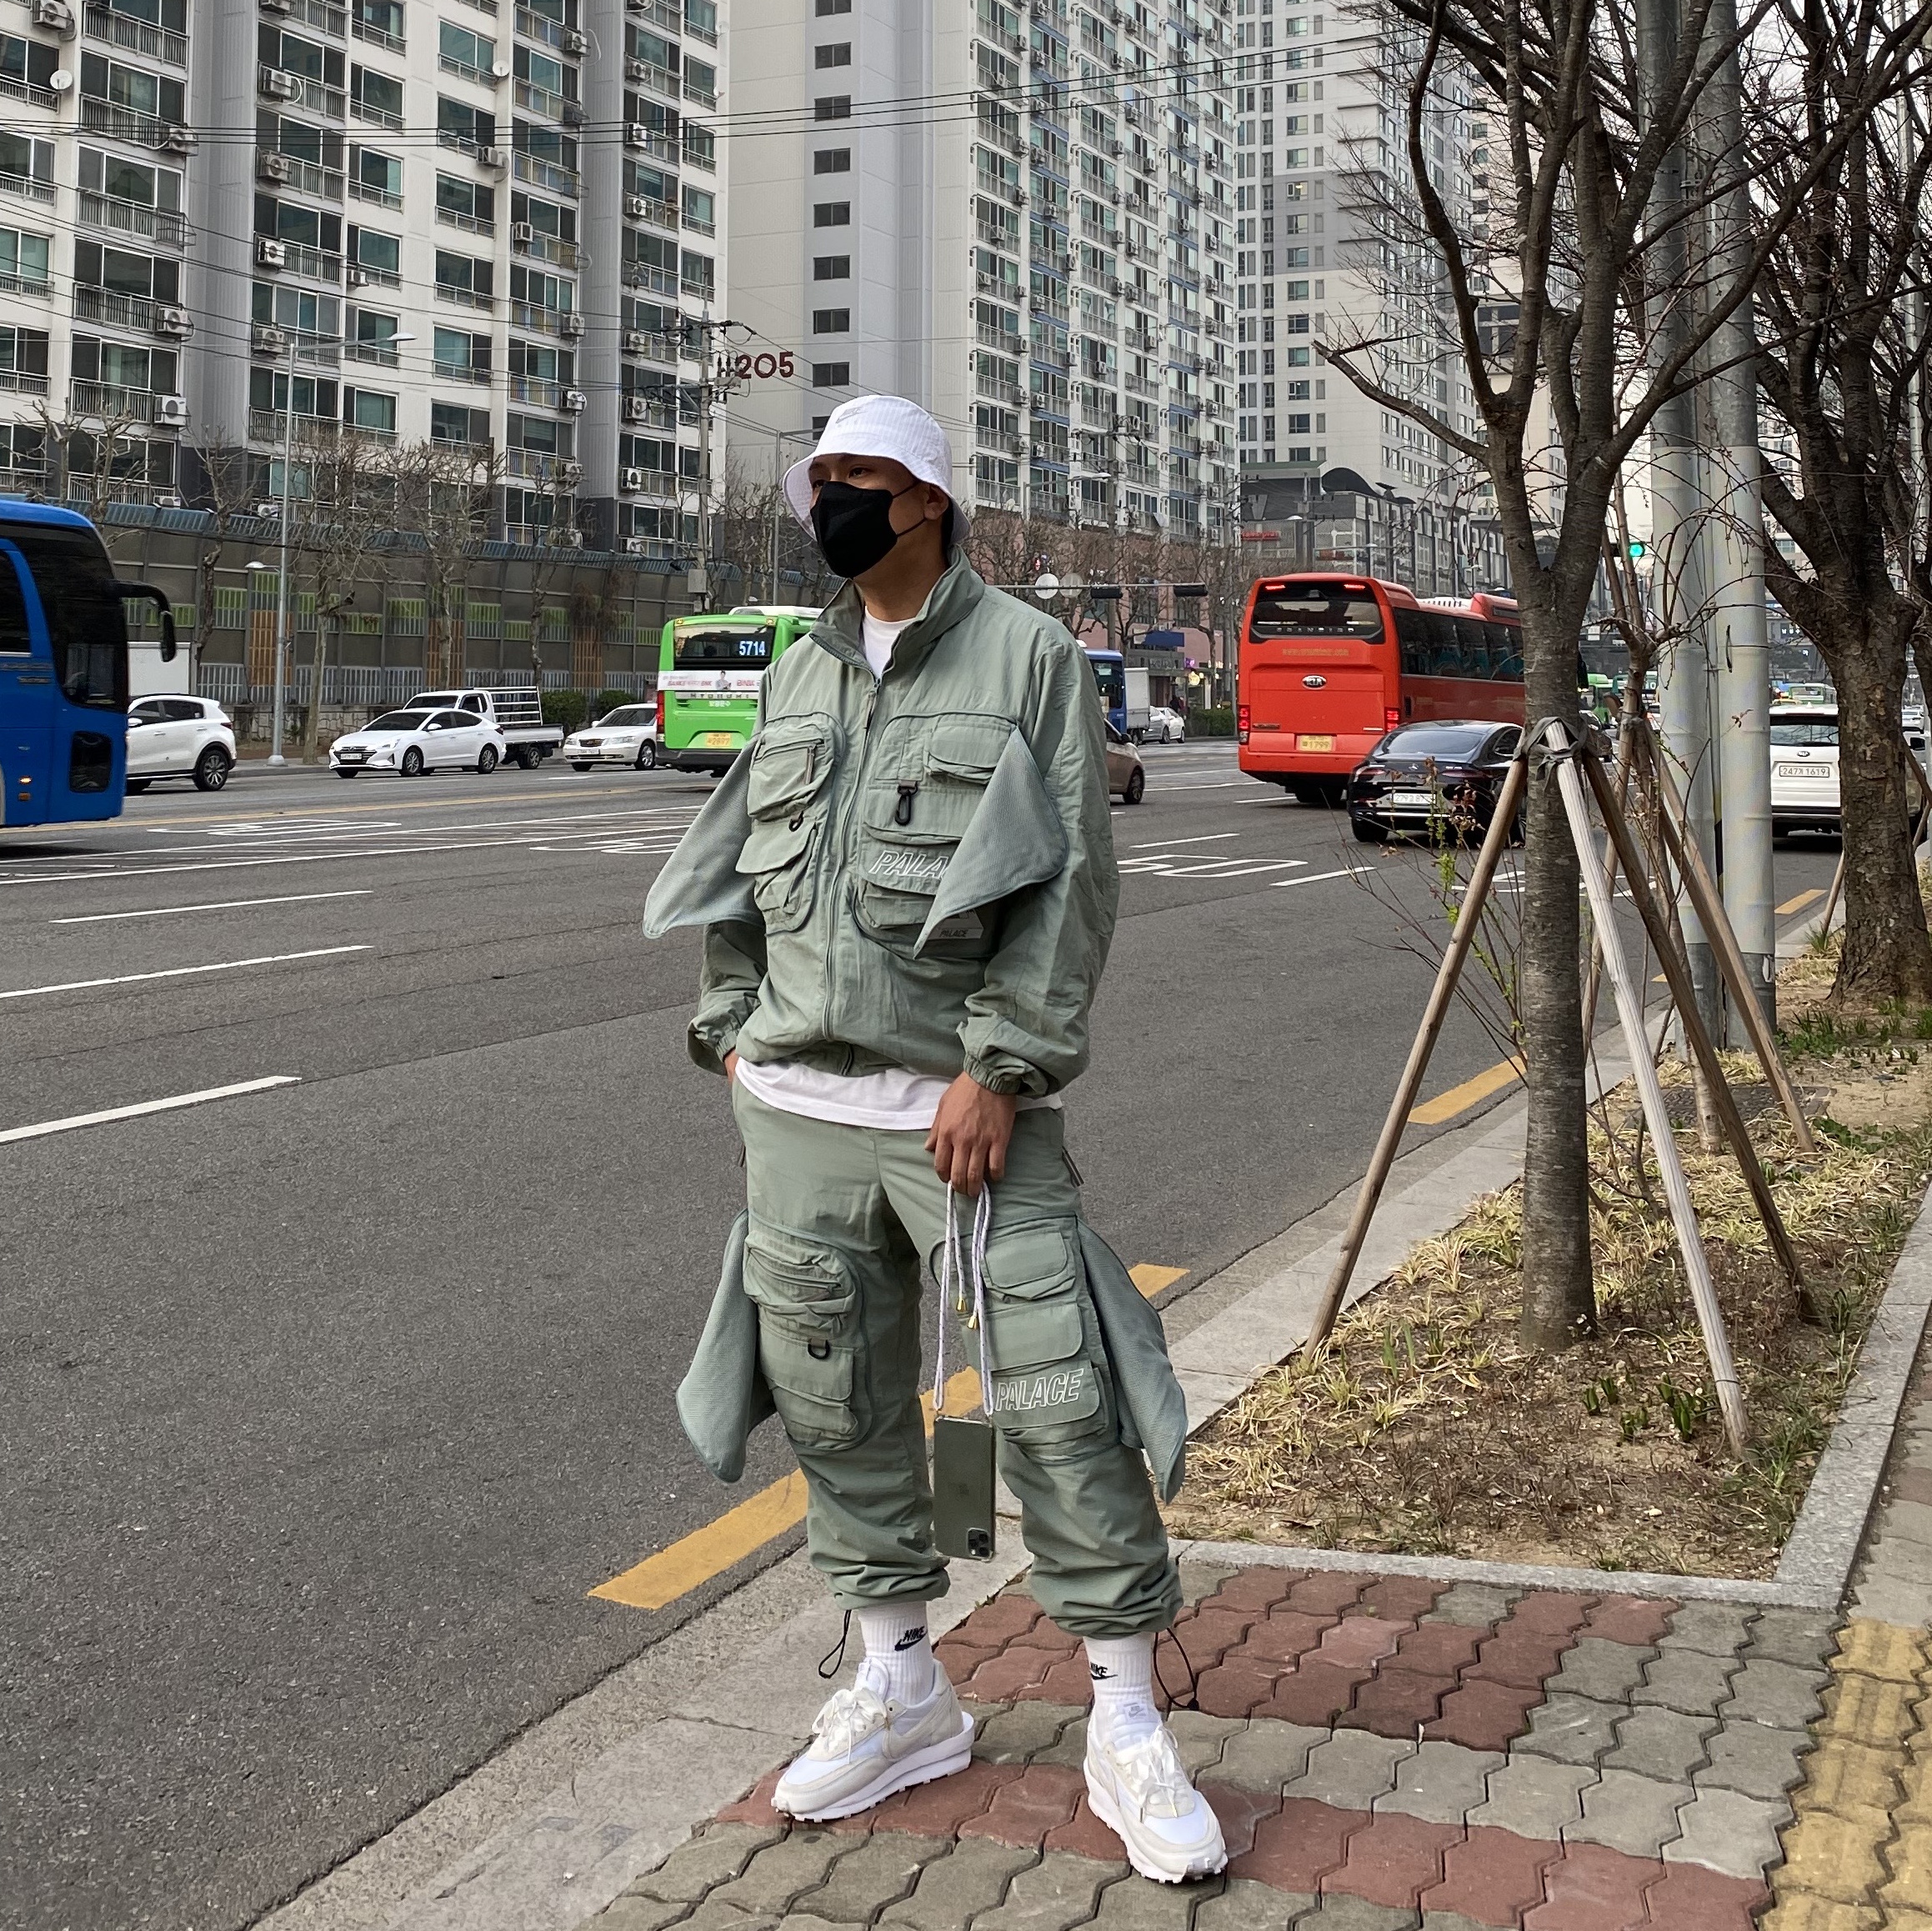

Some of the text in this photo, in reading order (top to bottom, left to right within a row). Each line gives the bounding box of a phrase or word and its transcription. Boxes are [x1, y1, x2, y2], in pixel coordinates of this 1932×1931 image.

[737, 352, 793, 379] 205
[738, 641, 766, 656] 5714
[1805, 768, 1826, 776] 1619
[868, 850, 948, 880] PALA
[995, 1368, 1084, 1412] PALACE
[902, 1625, 925, 1642] NIKE
